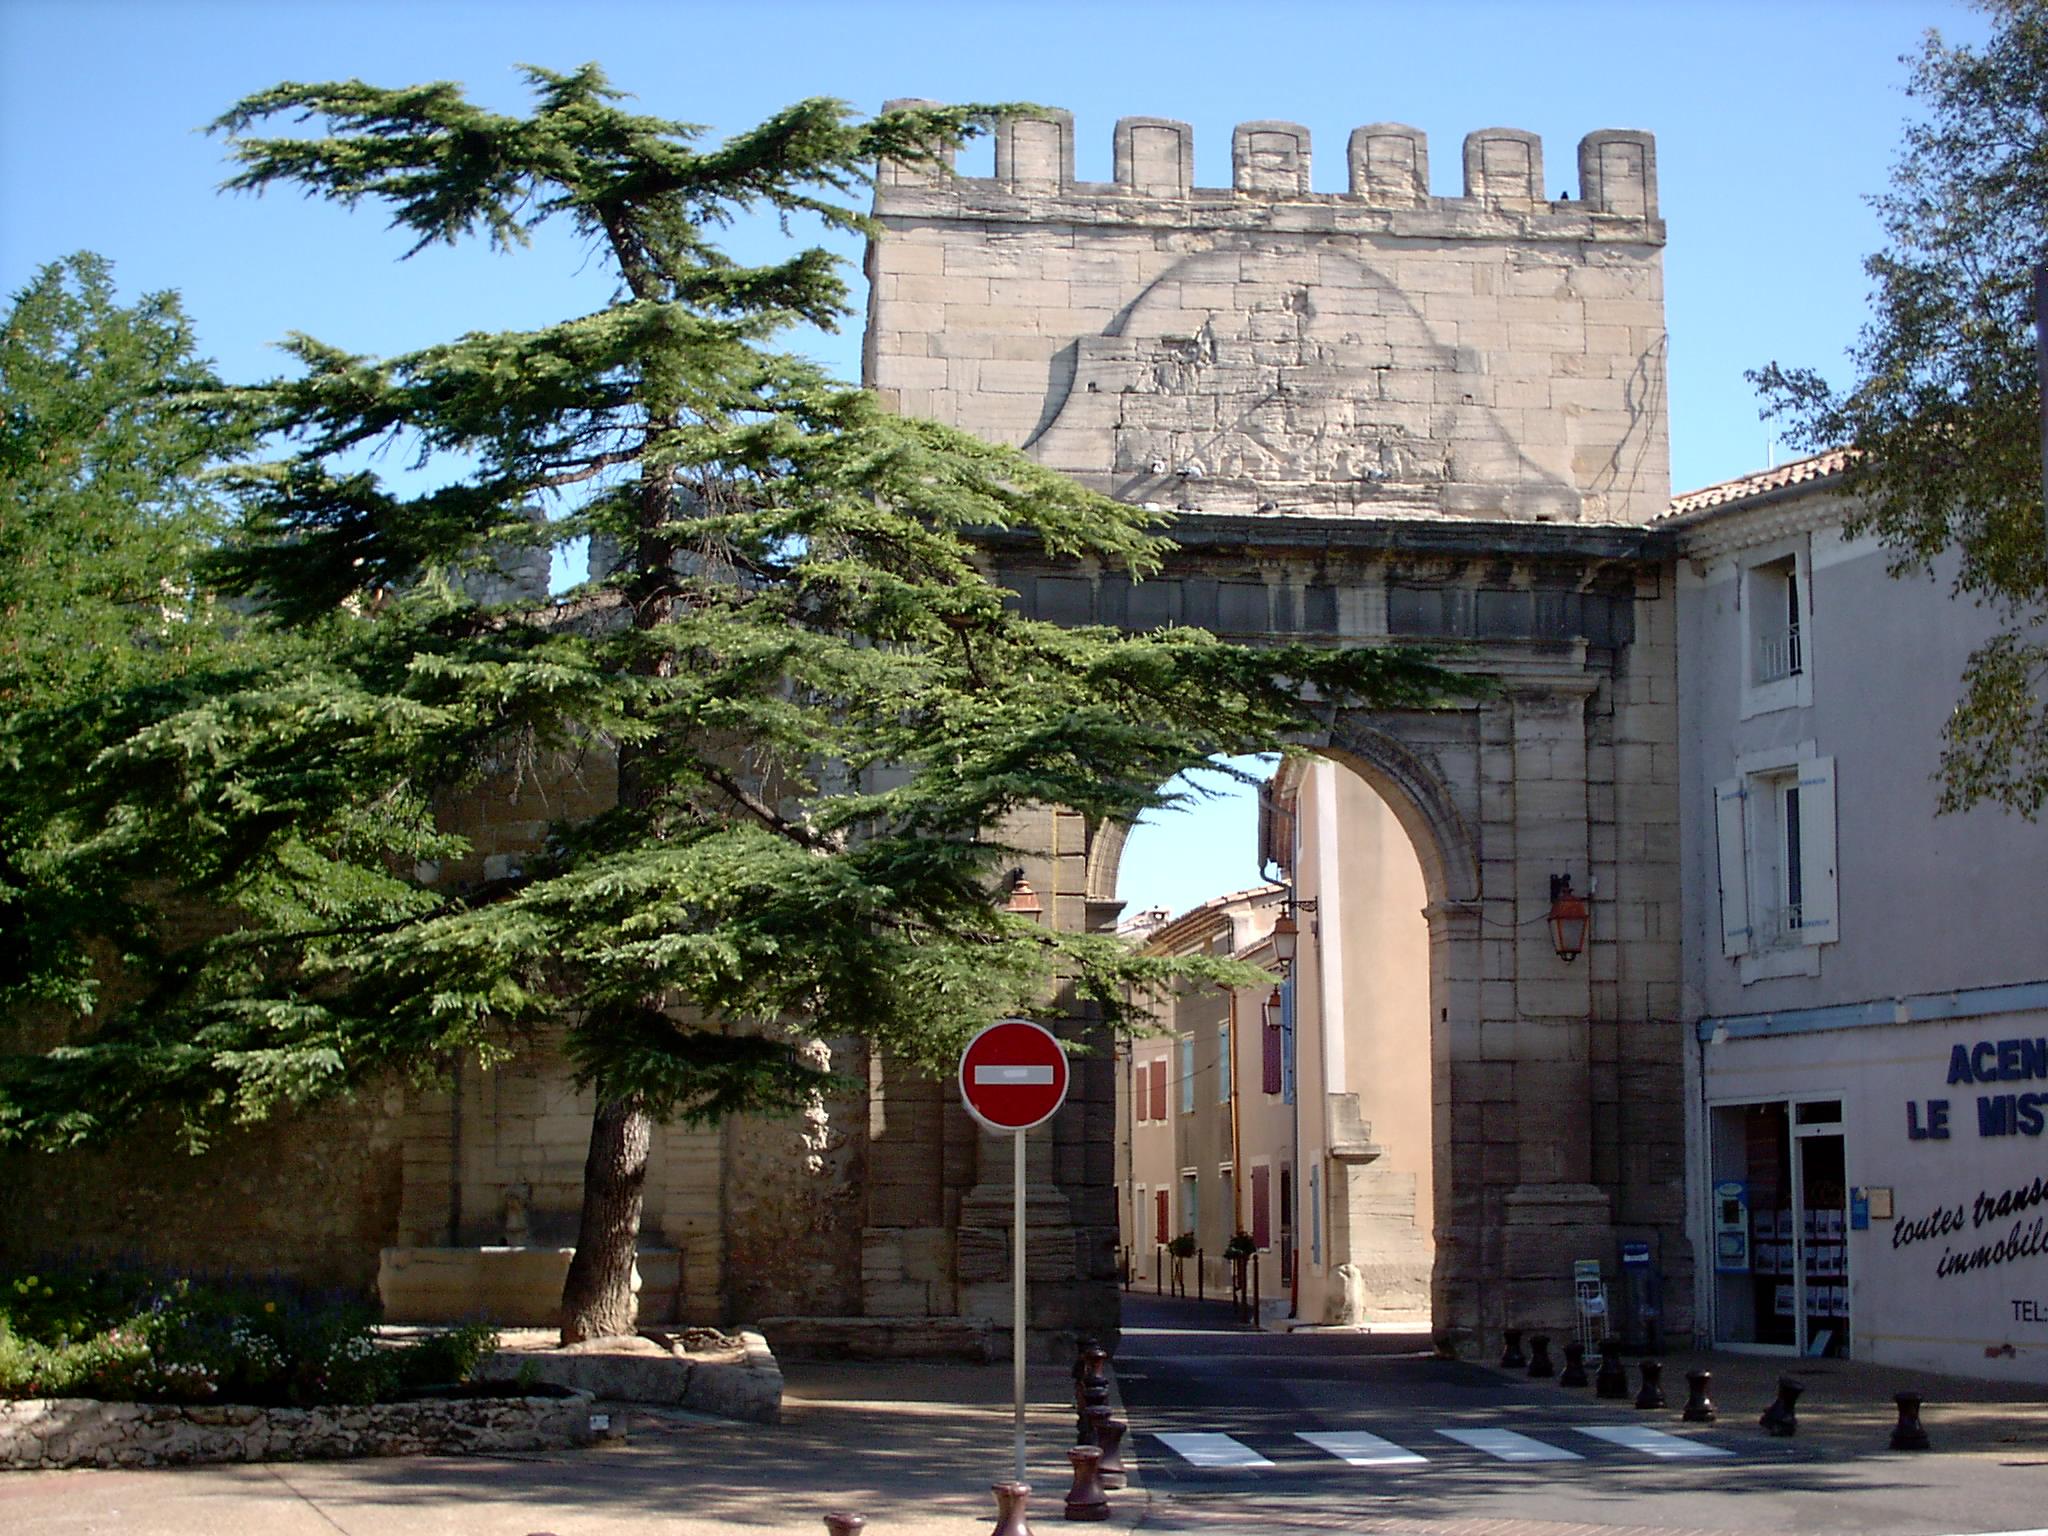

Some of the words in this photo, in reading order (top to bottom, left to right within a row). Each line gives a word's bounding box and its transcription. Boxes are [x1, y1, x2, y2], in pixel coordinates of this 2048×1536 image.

[1947, 1038, 2048, 1084] AGEN
[1907, 1099, 1950, 1140] LE
[1893, 1203, 1964, 1249] toutes
